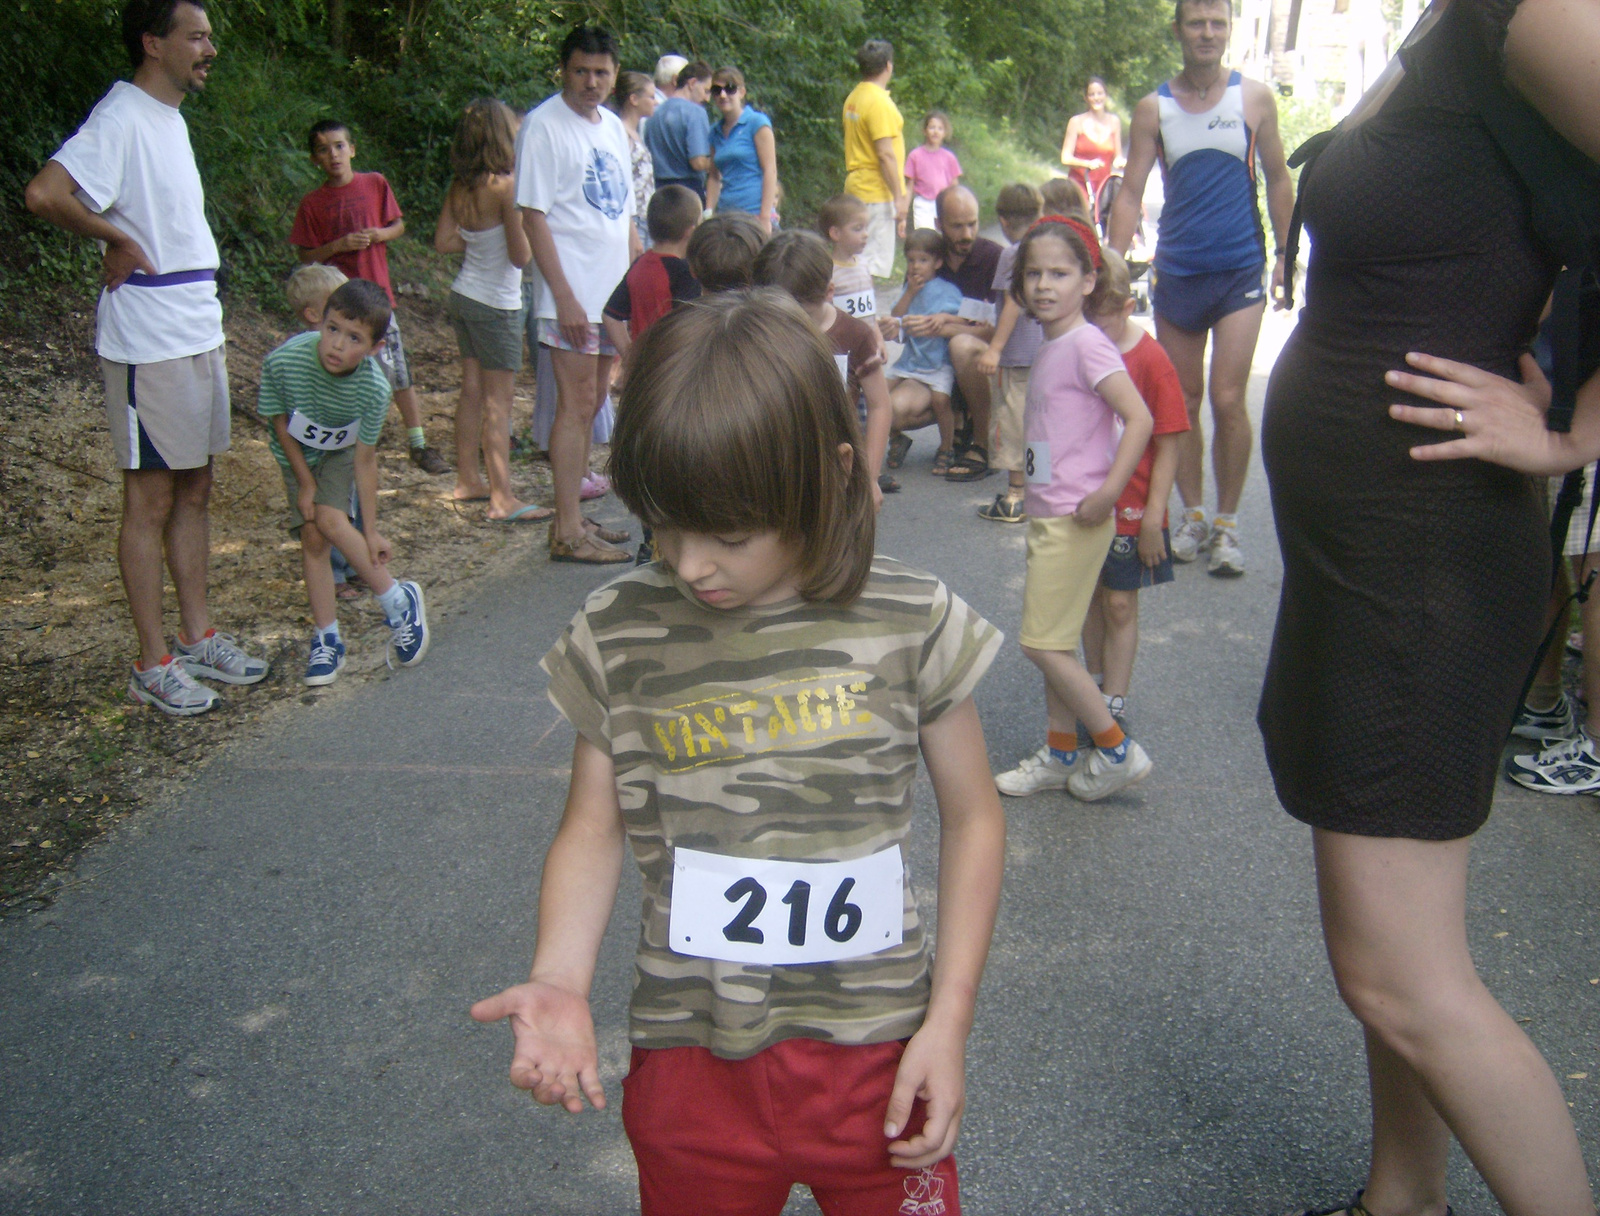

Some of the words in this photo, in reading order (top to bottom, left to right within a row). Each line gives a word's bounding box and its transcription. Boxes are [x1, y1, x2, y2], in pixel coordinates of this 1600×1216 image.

[846, 295, 872, 315] 366
[303, 425, 348, 445] 579
[654, 681, 872, 762] VINTAGE
[722, 876, 863, 947] 216
